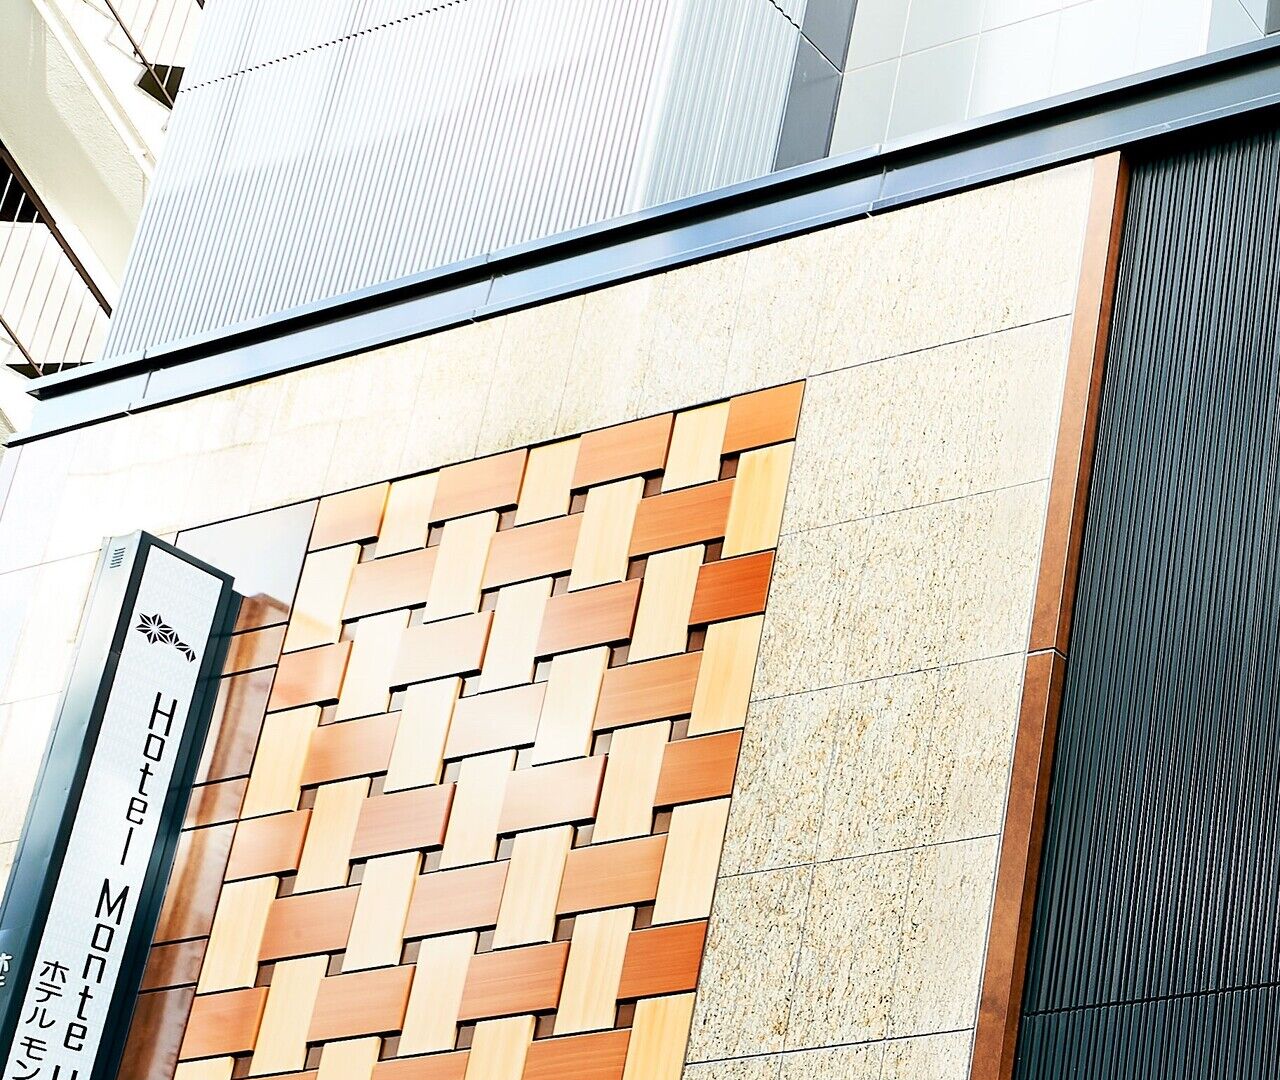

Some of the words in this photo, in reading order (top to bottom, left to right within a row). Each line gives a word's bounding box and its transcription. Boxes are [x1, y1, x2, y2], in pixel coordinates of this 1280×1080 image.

[119, 691, 178, 867] Hotel
[25, 960, 70, 1029] ホテル
[63, 877, 130, 1054] Monte
